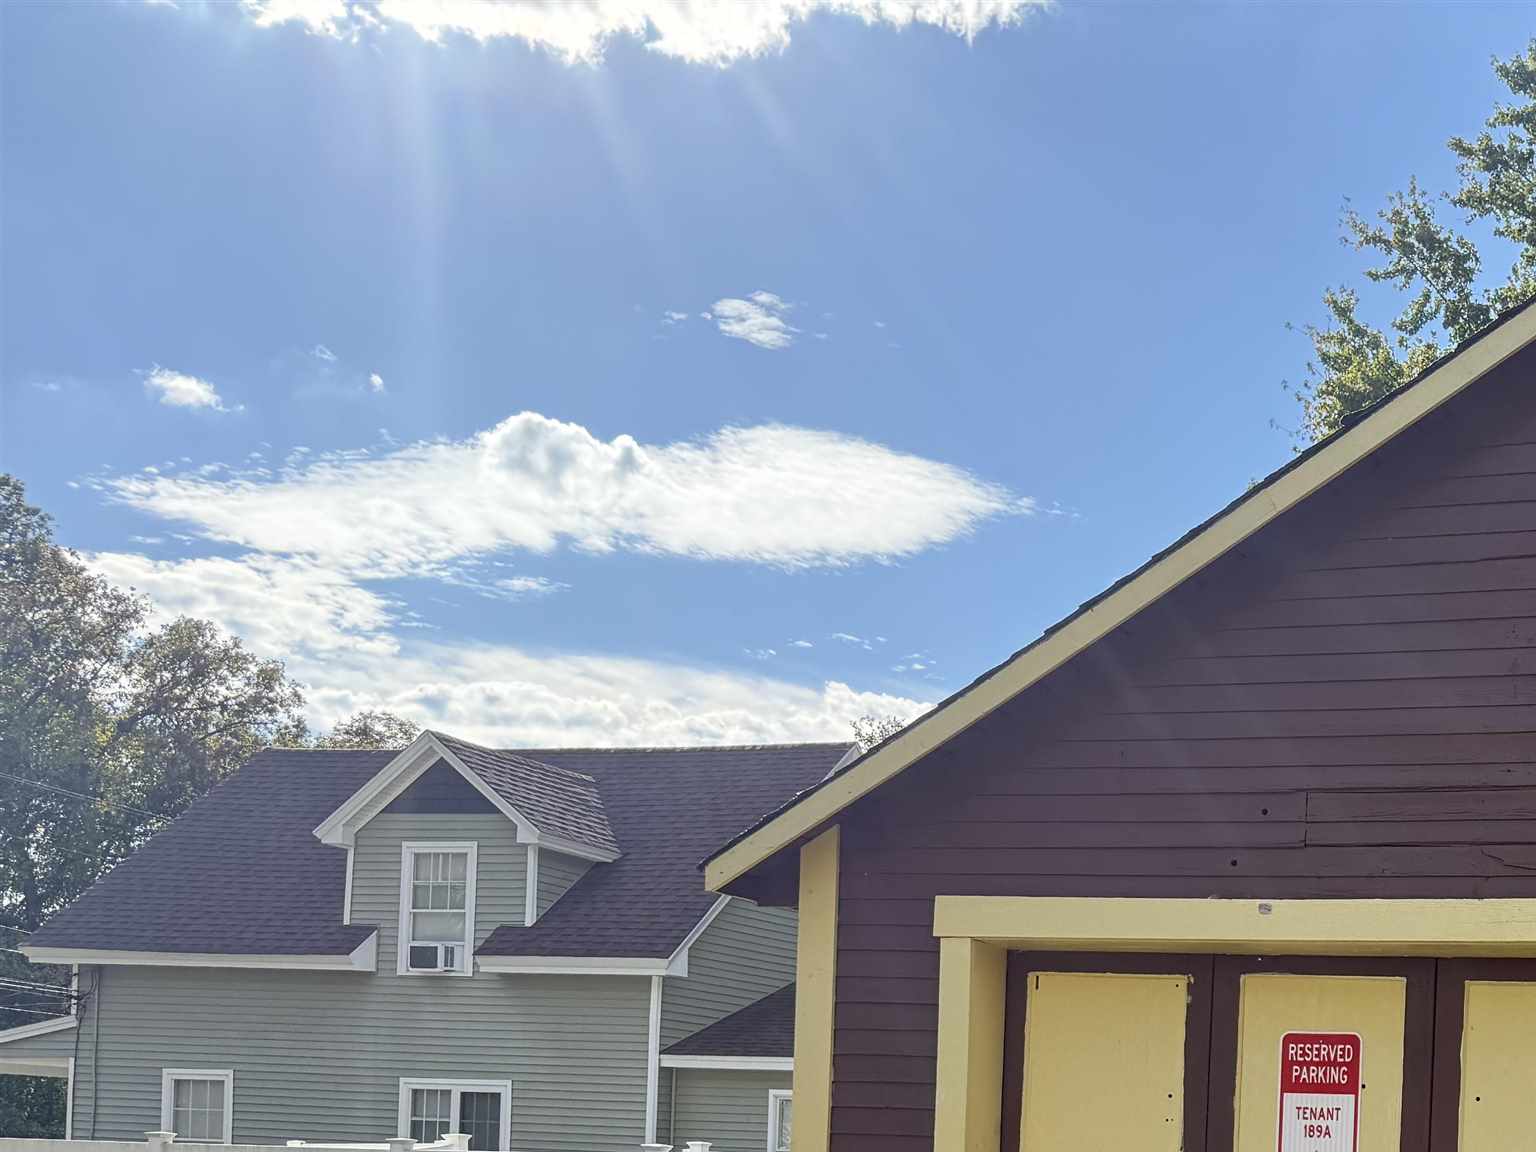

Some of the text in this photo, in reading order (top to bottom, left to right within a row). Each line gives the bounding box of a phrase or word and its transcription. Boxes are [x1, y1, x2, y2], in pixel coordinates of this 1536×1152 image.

[1288, 1043, 1353, 1062] RESERVED
[1292, 1065, 1348, 1084] PARKING
[1295, 1106, 1341, 1121] TENANT
[1304, 1124, 1331, 1139] 189A
